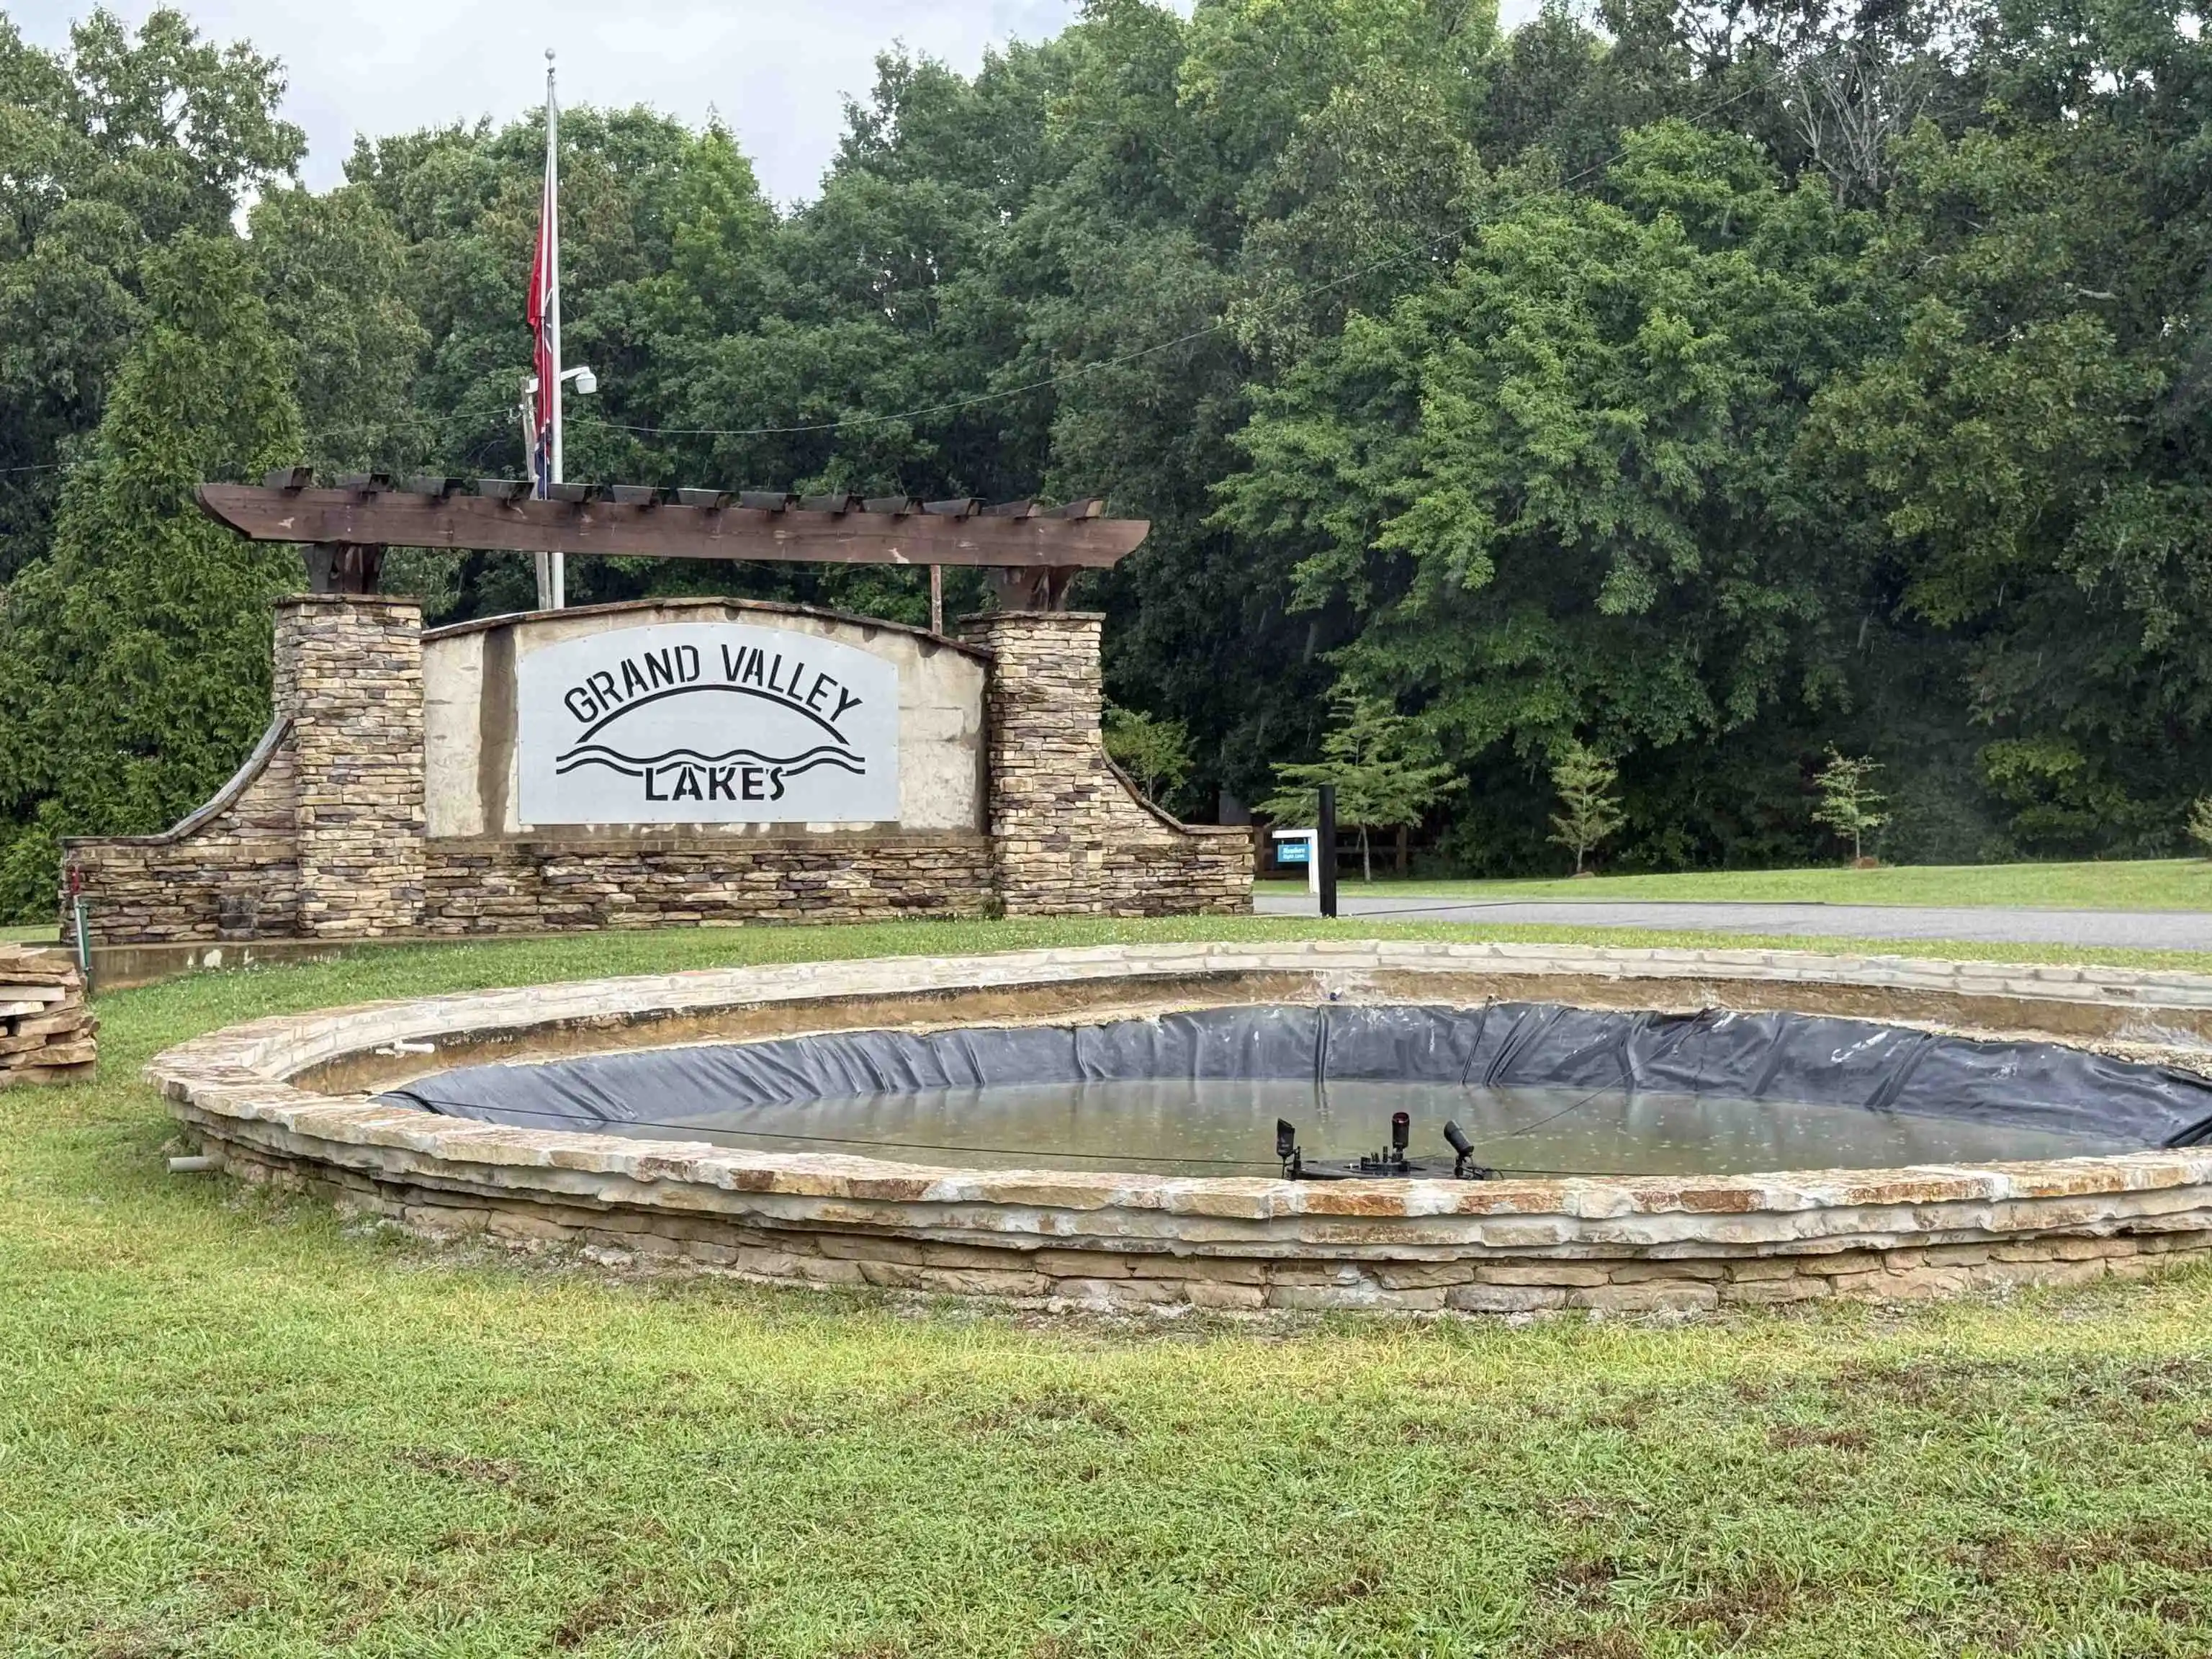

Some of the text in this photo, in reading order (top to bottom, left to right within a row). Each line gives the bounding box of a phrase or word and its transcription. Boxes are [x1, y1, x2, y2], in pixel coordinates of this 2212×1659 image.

[564, 644, 863, 723] GRAND VALLEY
[645, 766, 786, 801] LAKES
